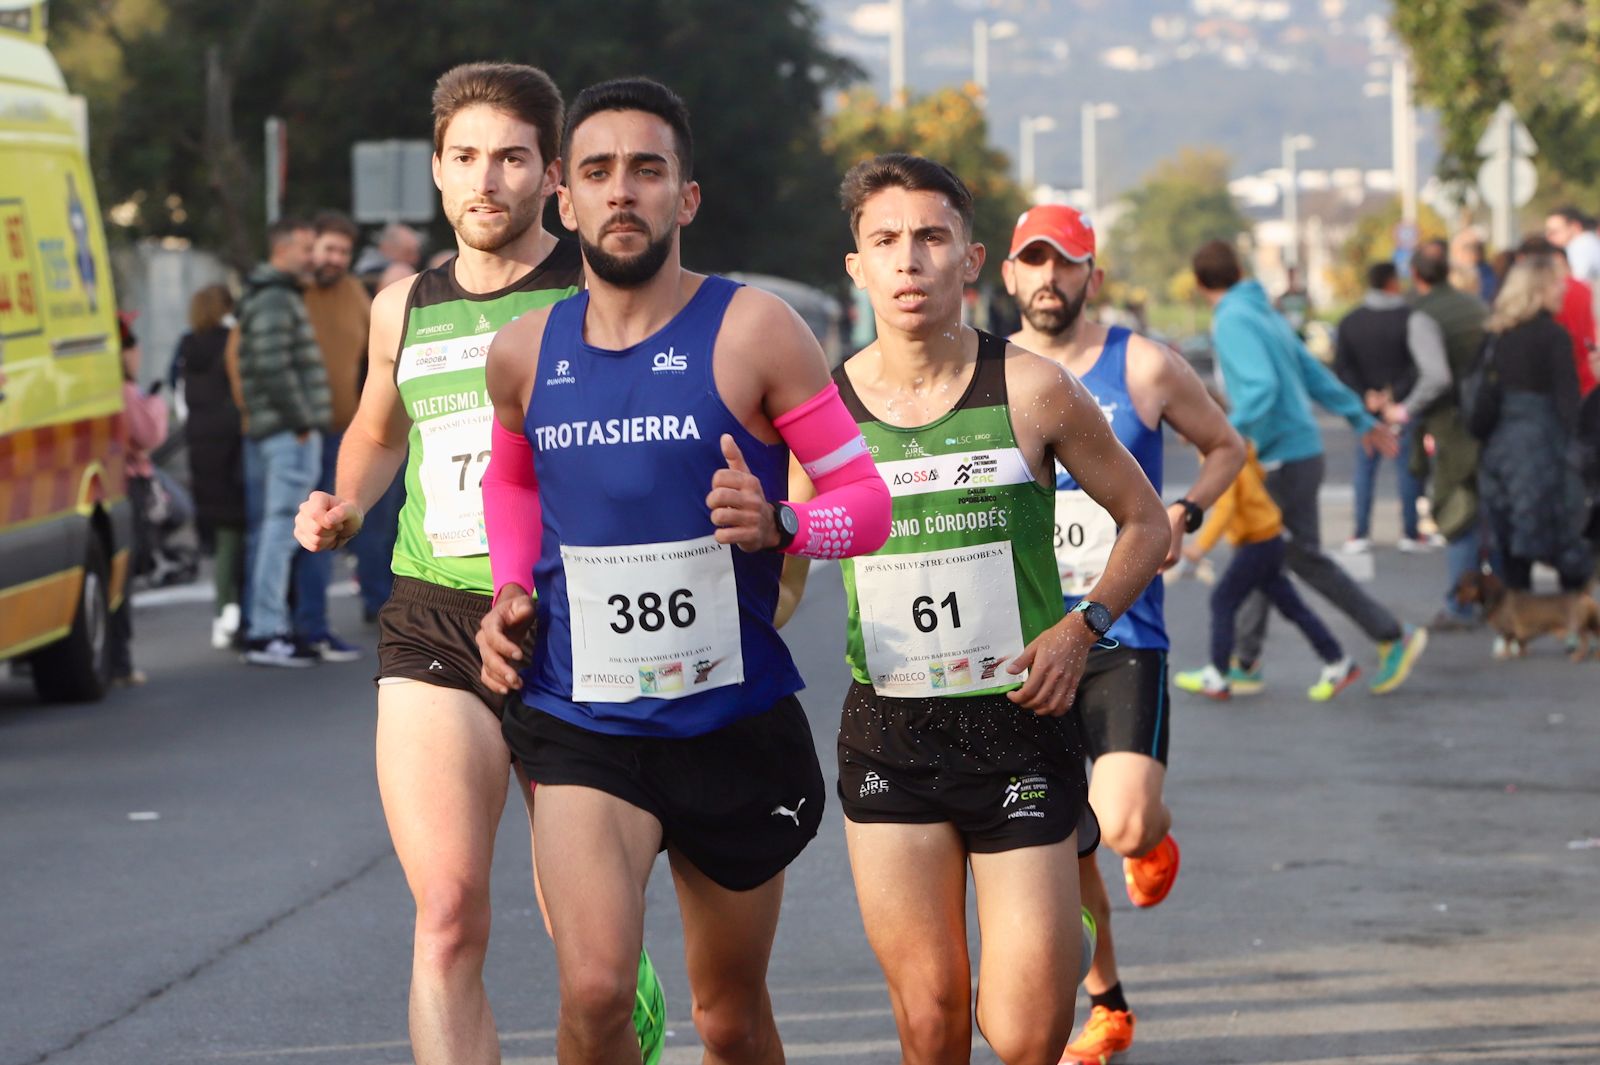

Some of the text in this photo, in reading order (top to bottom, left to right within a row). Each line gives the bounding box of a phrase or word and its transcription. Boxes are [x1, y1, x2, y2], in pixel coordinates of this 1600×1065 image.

[652, 346, 688, 371] als
[535, 415, 701, 451] TROTASIERRA
[956, 435, 972, 445] LSC
[905, 446, 925, 454] AIRE
[893, 468, 937, 485] AOSSA
[584, 557, 603, 565] SAN
[604, 553, 660, 565] SILVESTRE
[661, 543, 723, 561] CORDOBESA
[877, 564, 893, 572] SAN
[894, 557, 945, 571] SILVESTRE
[945, 548, 1004, 564] CORDOBESA
[607, 588, 697, 634] 386
[912, 591, 962, 633] 61
[680, 645, 713, 659] VELASCO
[905, 644, 990, 663] CARLOS BARBERO MORENO
[593, 673, 635, 685] IMDECO
[886, 671, 926, 683] IMDECO
[859, 779, 889, 794] AIRE
[859, 787, 889, 798] SPORT
[1020, 790, 1046, 800] CAC
